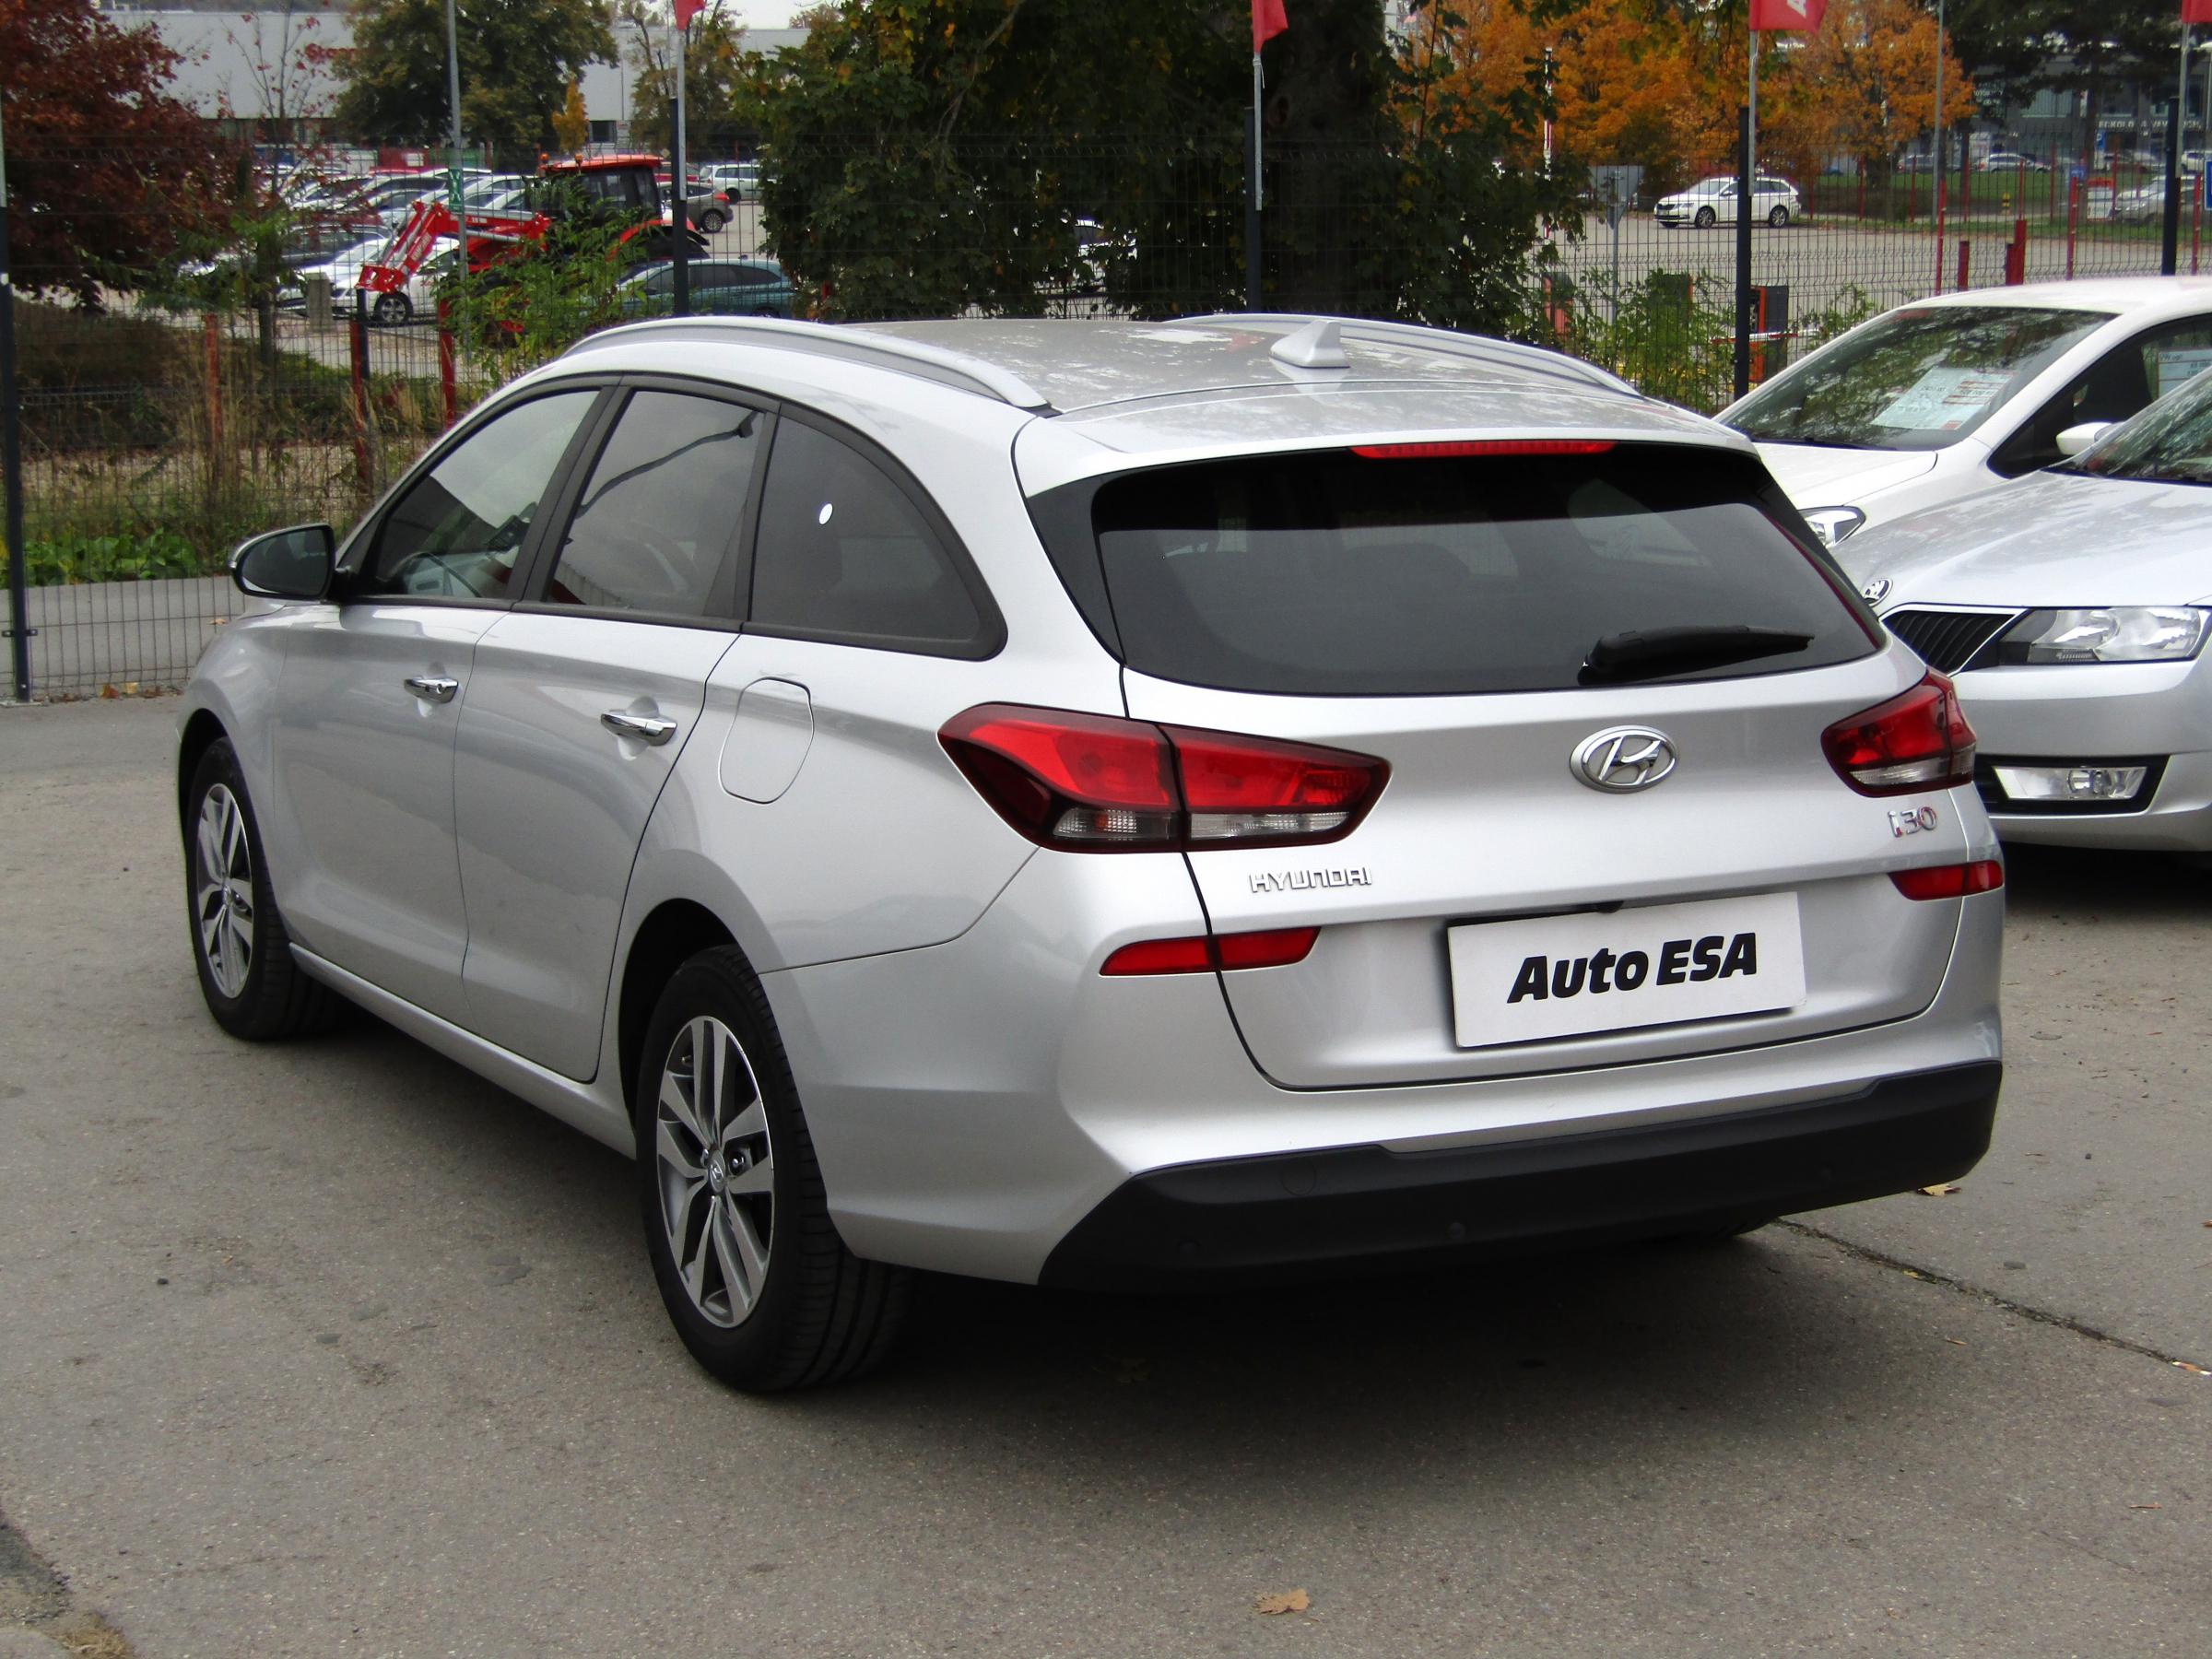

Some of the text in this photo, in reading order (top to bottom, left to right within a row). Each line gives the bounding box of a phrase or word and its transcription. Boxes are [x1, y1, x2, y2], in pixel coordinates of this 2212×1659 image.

[1888, 806, 1937, 838] i30
[1249, 866, 1372, 893] HYUNDAI
[1506, 932, 1757, 1004] Auto ESA
